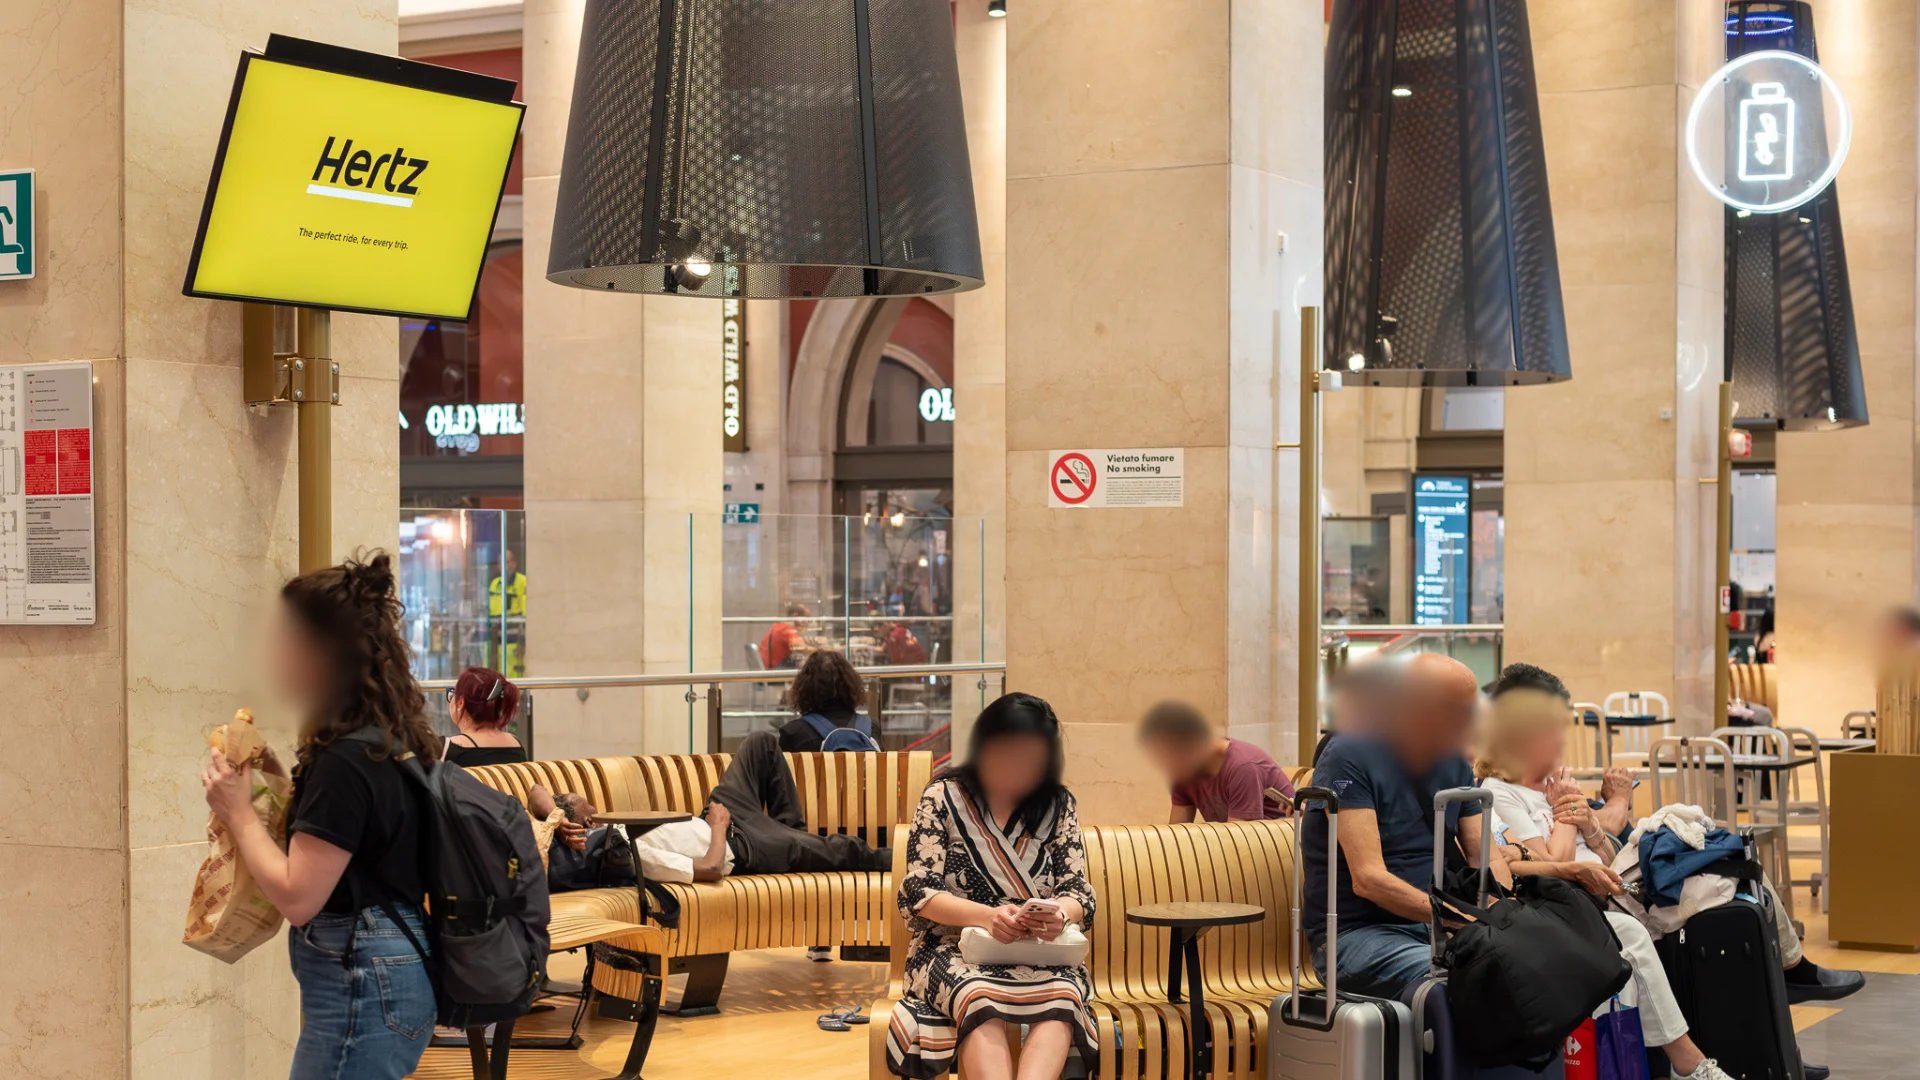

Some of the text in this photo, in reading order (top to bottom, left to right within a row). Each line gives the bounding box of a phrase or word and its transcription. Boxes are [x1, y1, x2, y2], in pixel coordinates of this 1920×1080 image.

[312, 136, 429, 195] Hertz
[299, 227, 408, 251] The perfect ride, for every trip.
[725, 319, 739, 382] WILD
[425, 404, 477, 436] OLD
[725, 384, 739, 437] OLD
[1107, 454, 1175, 463] Vietato fumare
[1107, 464, 1161, 474] No smoking
